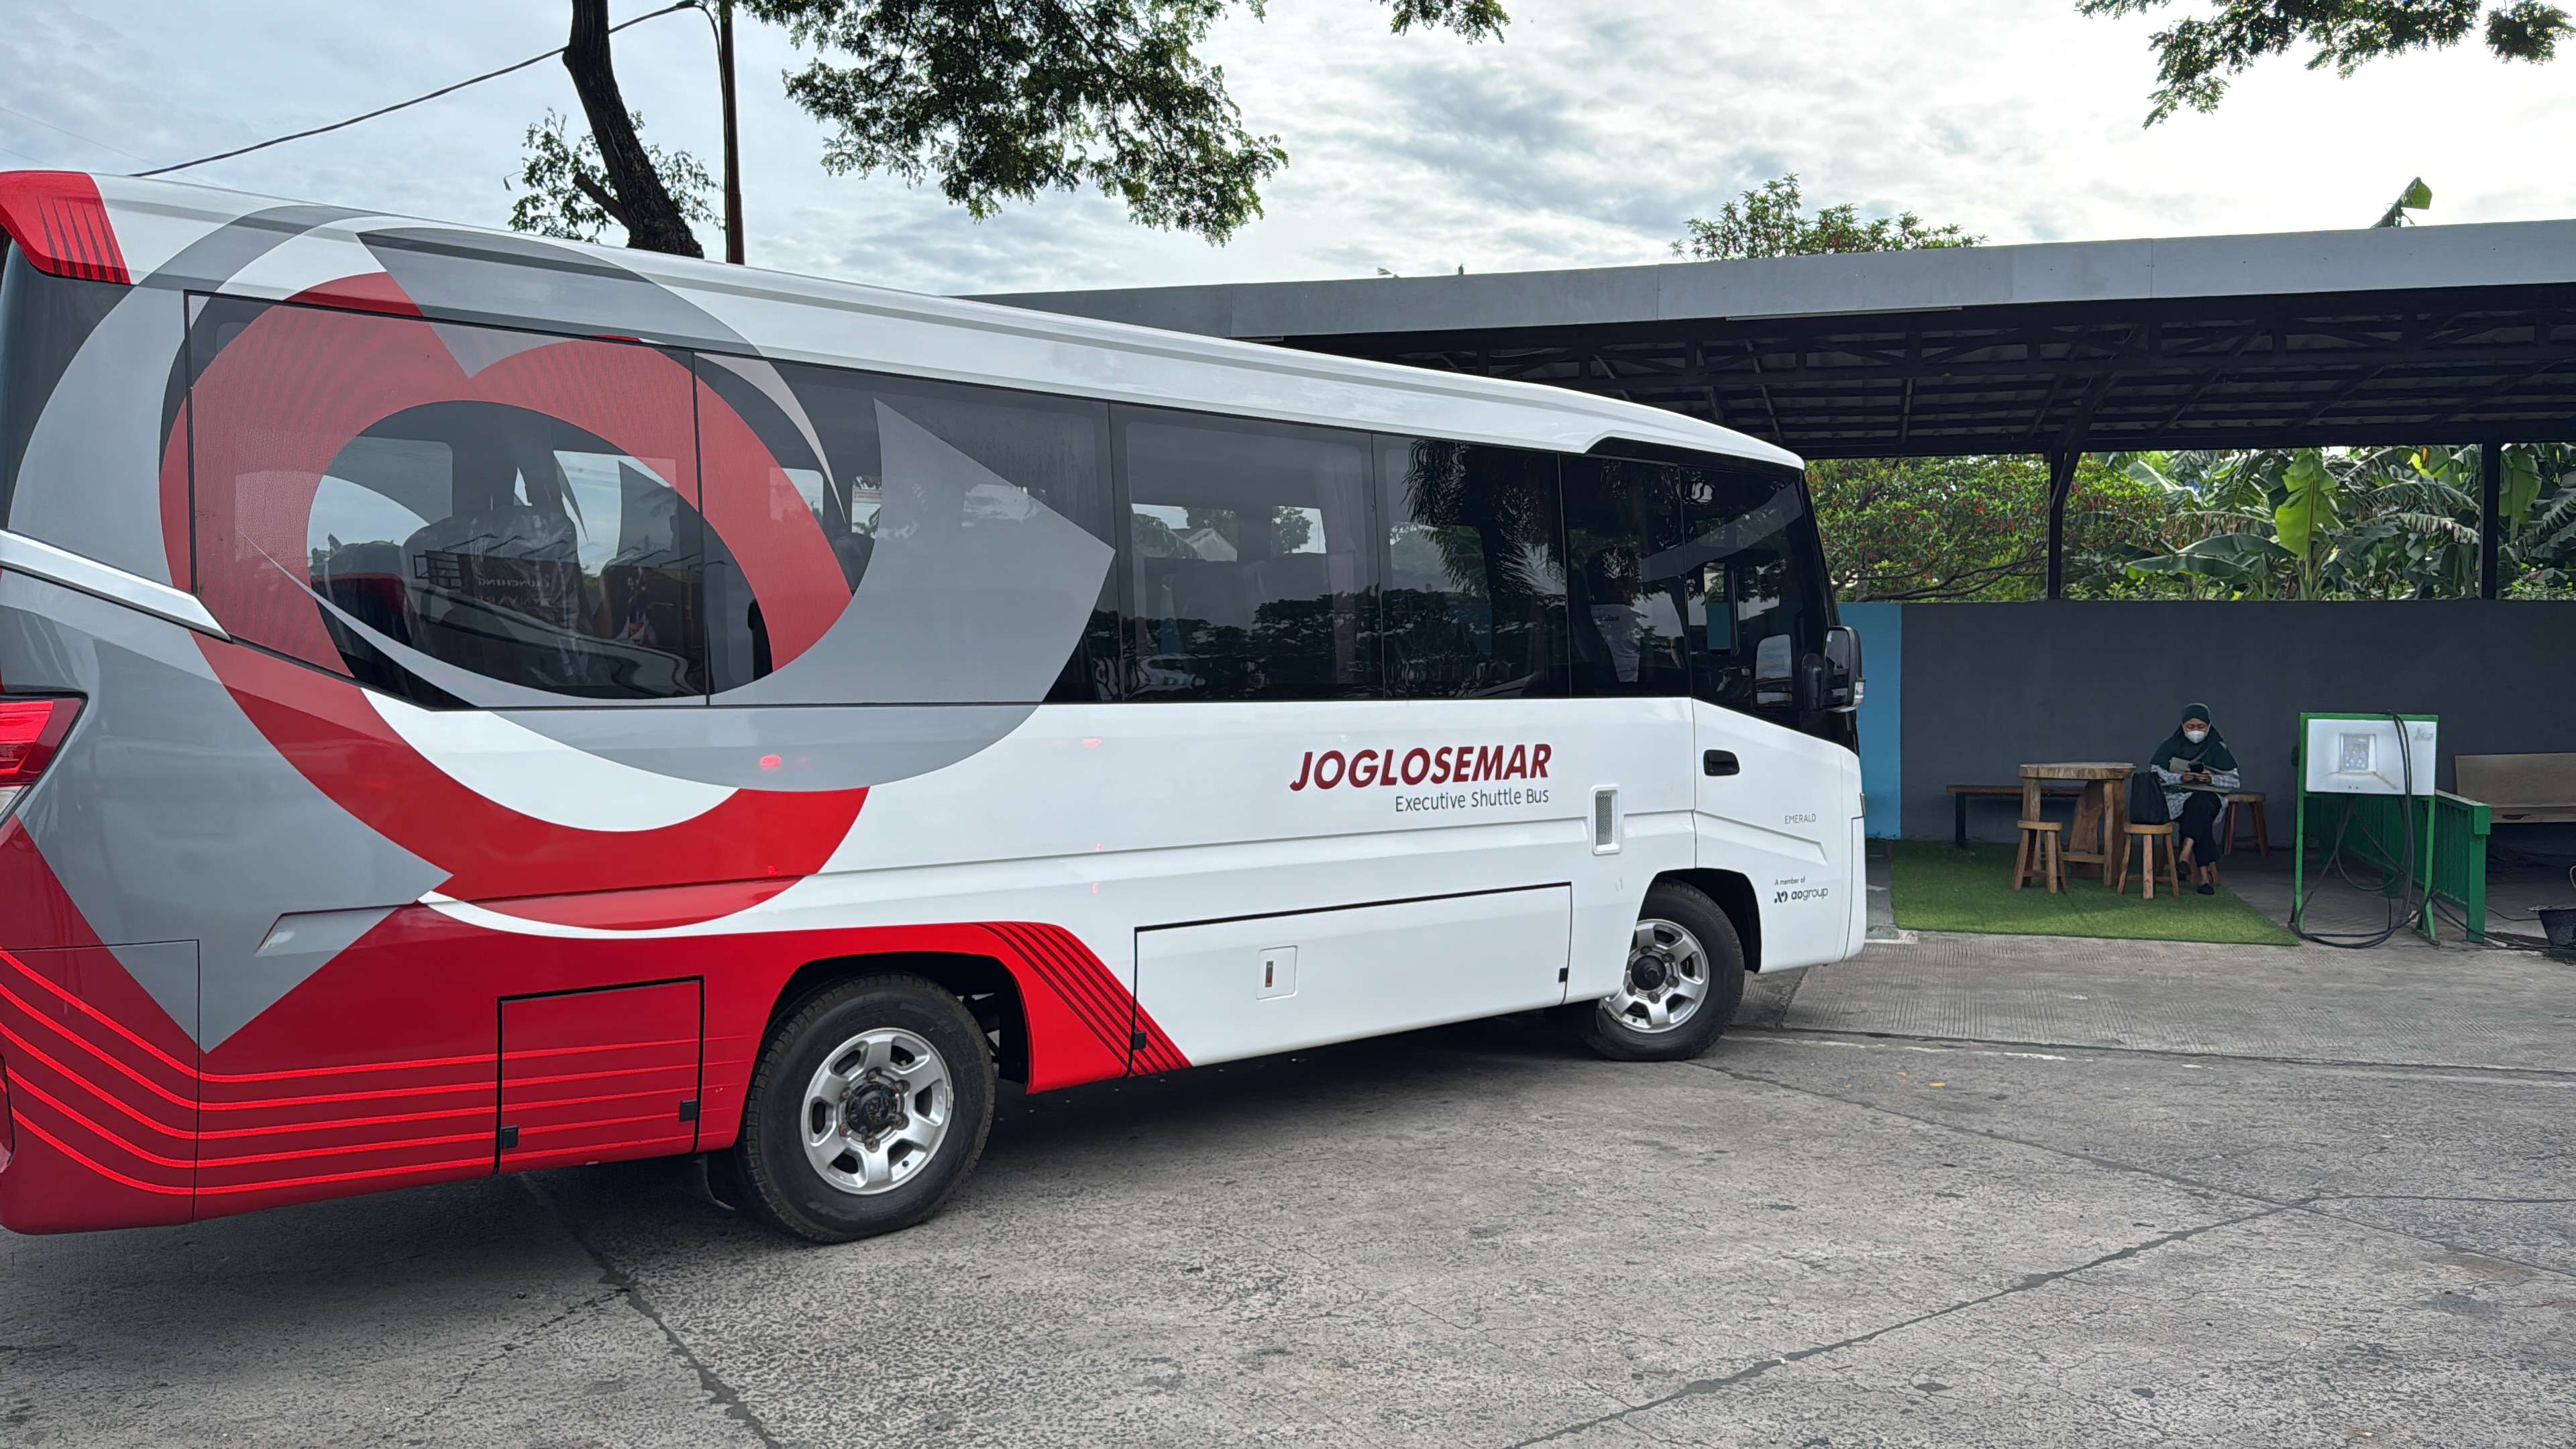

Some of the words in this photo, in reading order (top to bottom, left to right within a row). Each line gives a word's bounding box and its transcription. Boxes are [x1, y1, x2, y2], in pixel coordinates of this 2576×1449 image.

[1289, 743, 1552, 792] JOGLOSEMAR
[1395, 792, 1466, 812] Executive
[1471, 788, 1521, 807] Shuttle
[1526, 788, 1549, 804] Bus
[1784, 813, 1817, 824] EMERALD
[1774, 878, 1779, 886] A
[1779, 877, 1799, 885] member
[1801, 875, 1806, 884] of
[1791, 888, 1829, 901] aogroup
